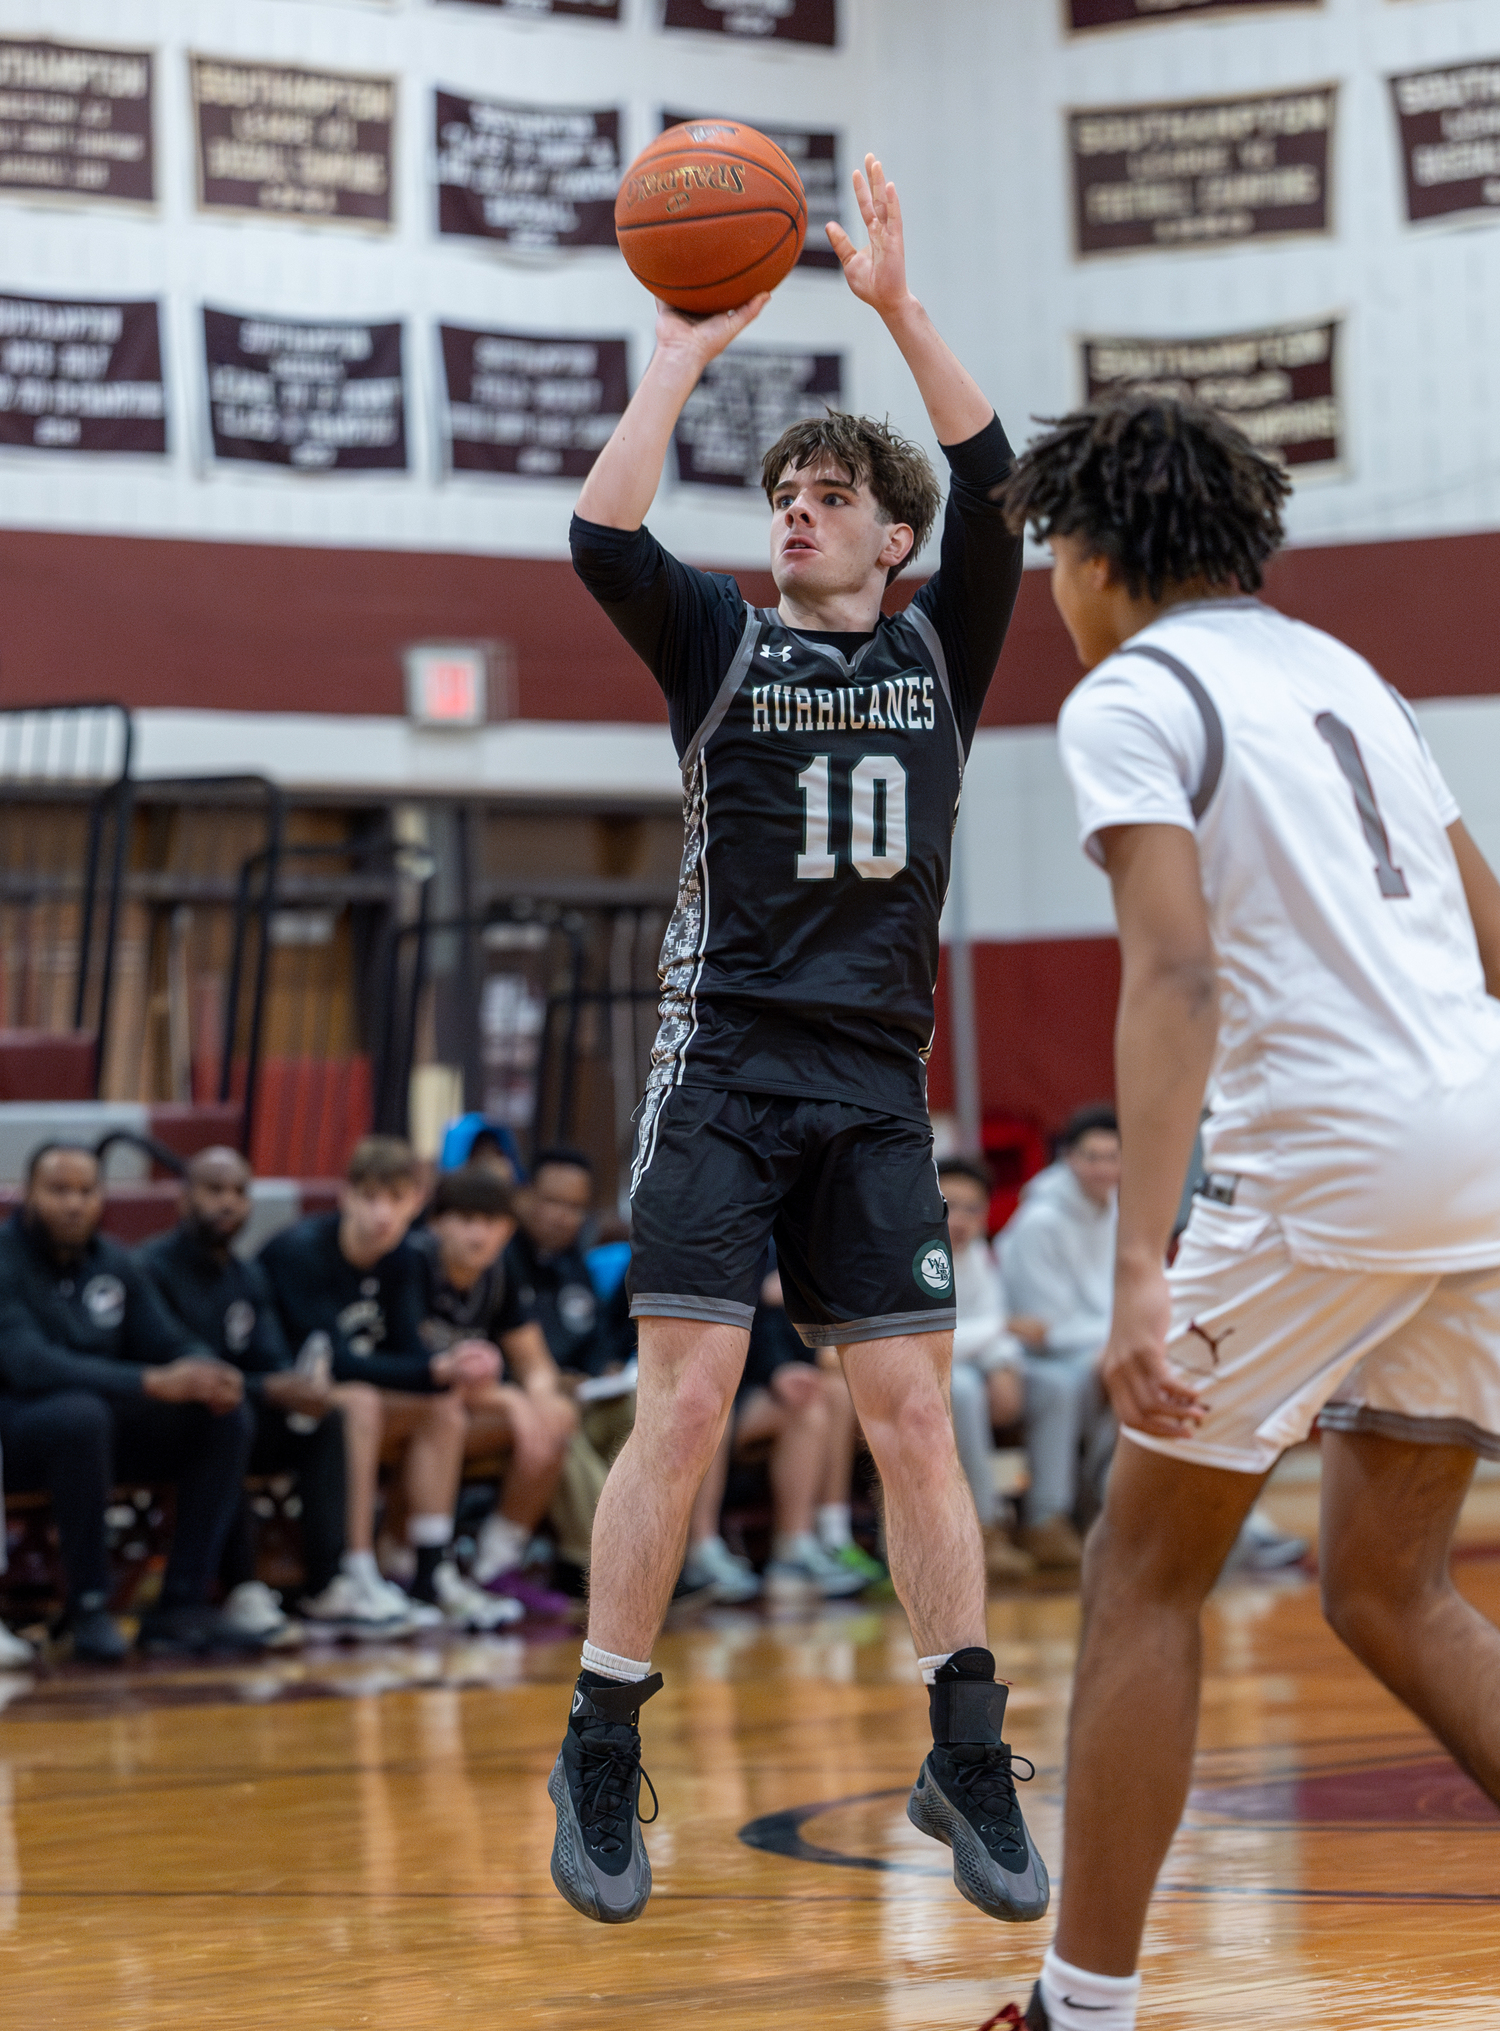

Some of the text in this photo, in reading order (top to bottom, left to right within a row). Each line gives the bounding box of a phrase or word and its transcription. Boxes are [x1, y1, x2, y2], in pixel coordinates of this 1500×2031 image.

[627, 164, 746, 208] SPALDING
[752, 676, 935, 732] HURRICANES
[794, 753, 909, 881] 10
[1314, 711, 1410, 898] 1
